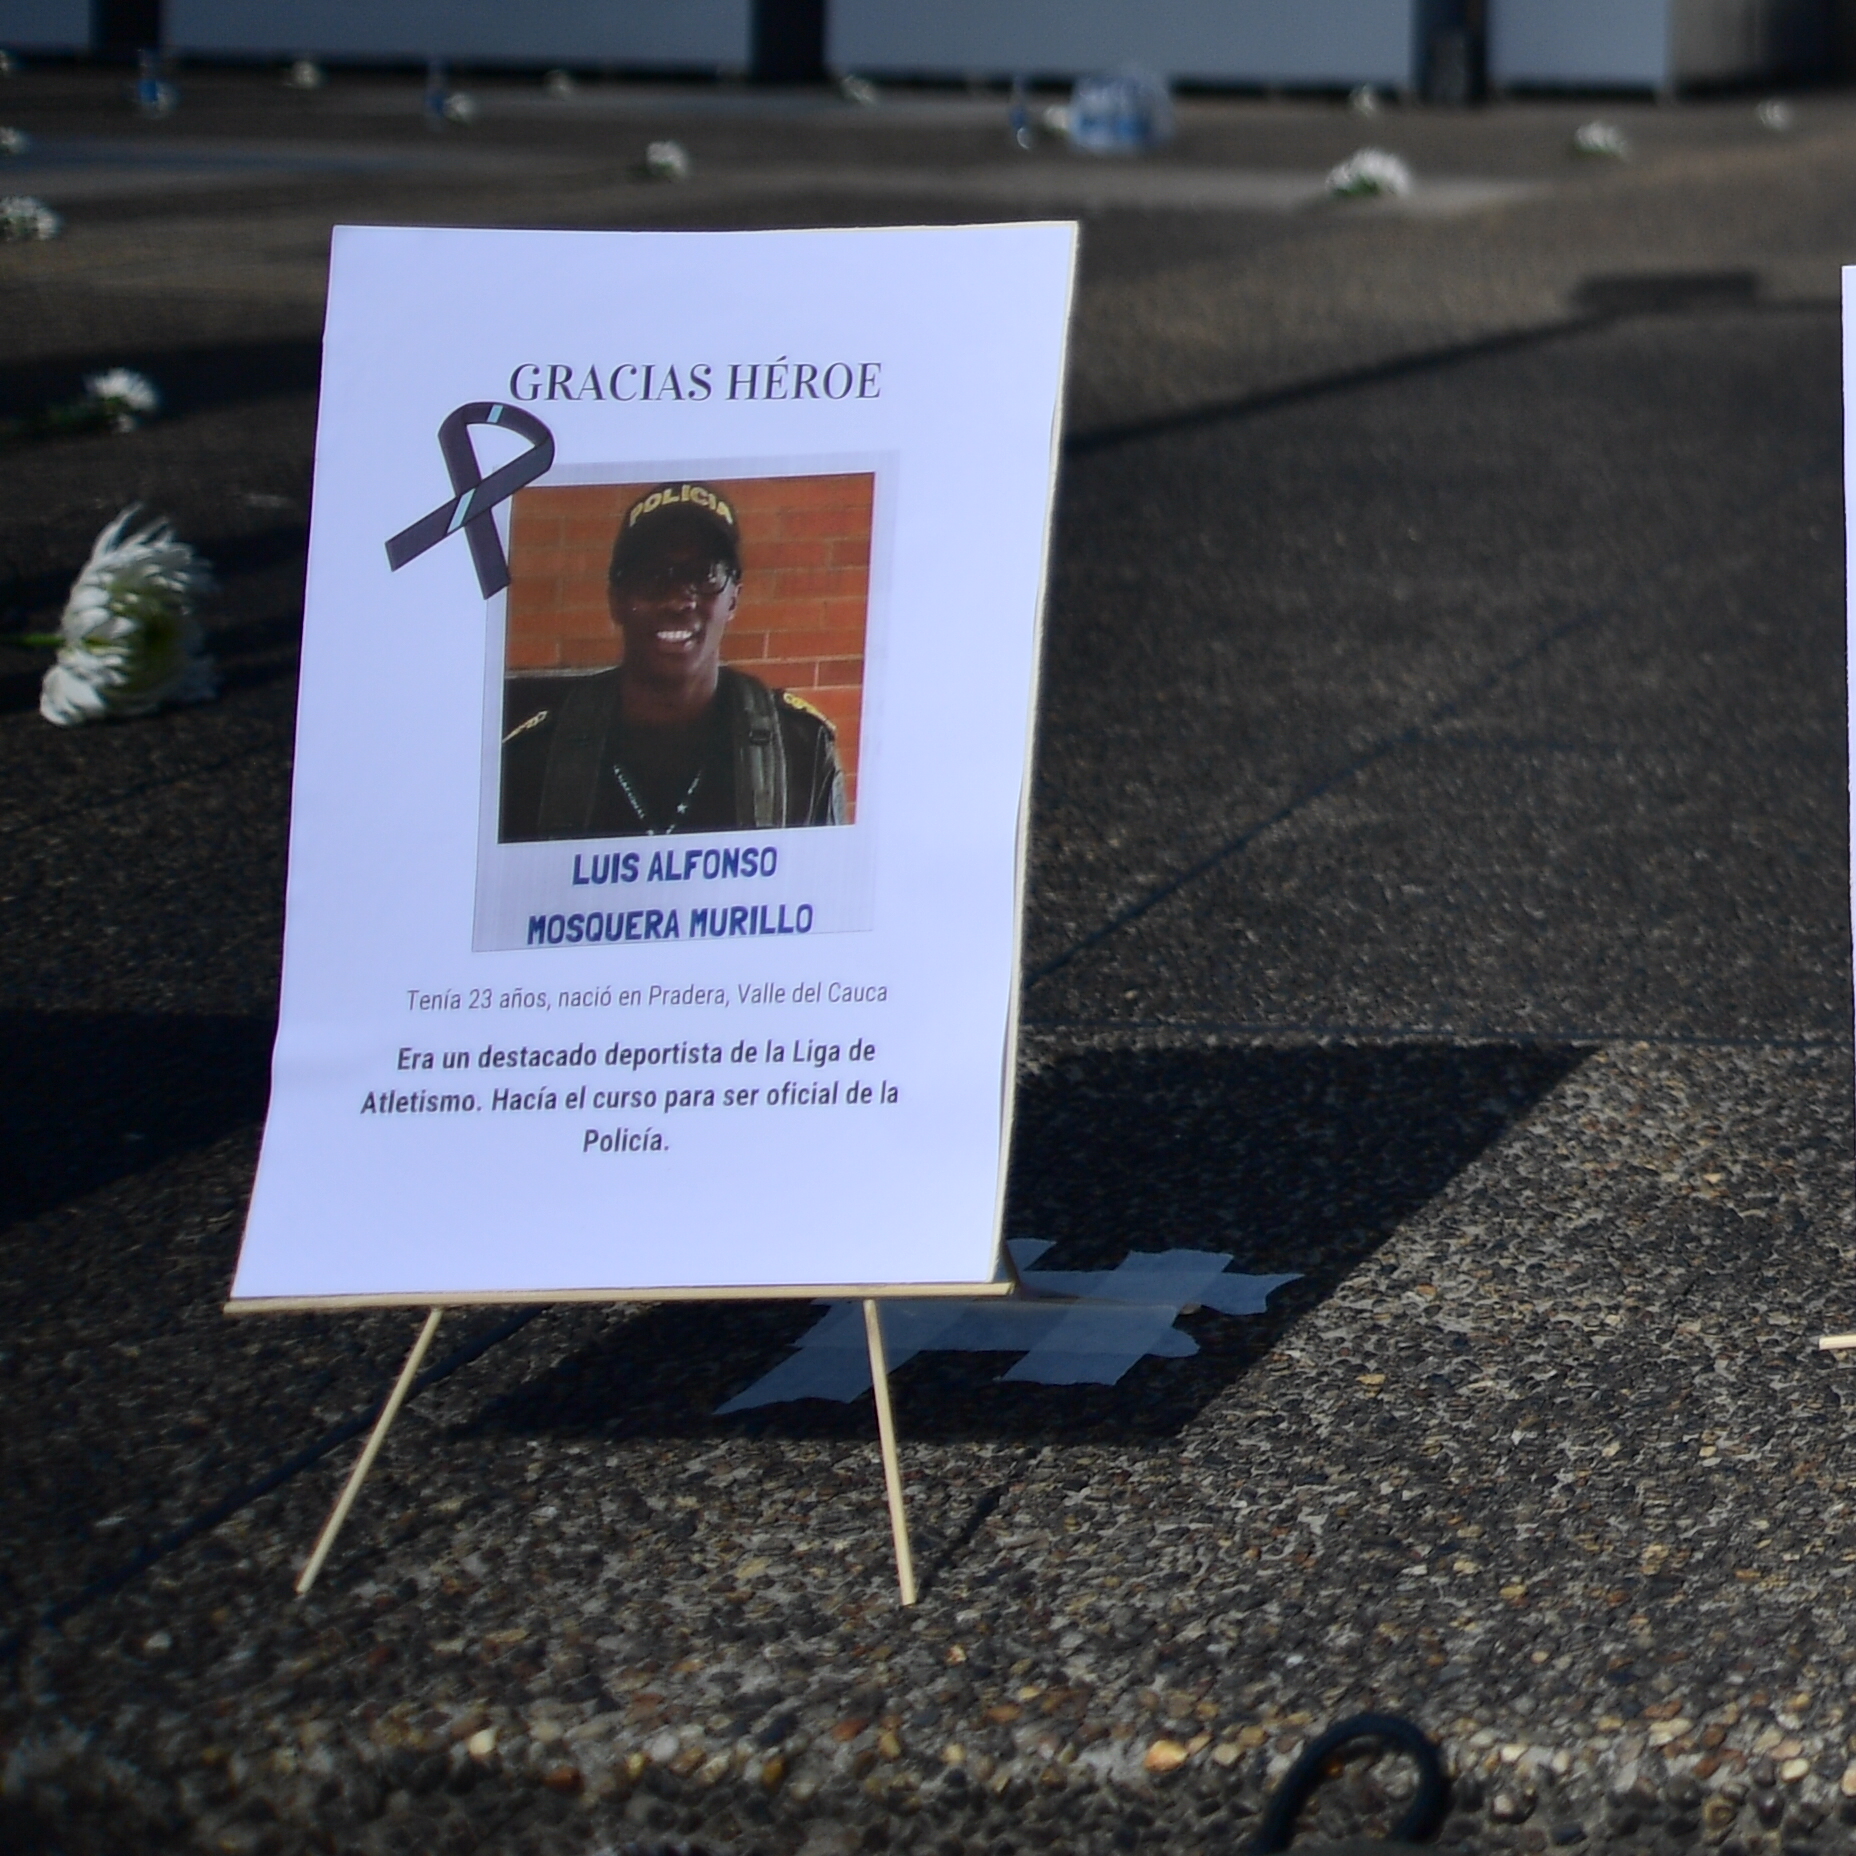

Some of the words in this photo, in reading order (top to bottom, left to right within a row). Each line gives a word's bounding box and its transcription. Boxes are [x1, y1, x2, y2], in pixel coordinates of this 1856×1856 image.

[510, 363, 712, 401] GRACIAS
[726, 355, 881, 400] HÉROE
[630, 484, 733, 527] POLICIA
[572, 852, 640, 885] LUIS
[647, 846, 777, 882] ALFONSO
[527, 909, 680, 945] MOSQUERA
[689, 904, 813, 938] MURILLO
[407, 988, 461, 1011] Tenía
[468, 988, 492, 1009] 23
[499, 987, 551, 1011] años,
[558, 985, 612, 1007] nació
[619, 990, 641, 1006] en
[648, 984, 730, 1008] Pradera,
[738, 982, 786, 1004] Valle
[792, 981, 822, 1003] del
[828, 982, 887, 1003] Cauca
[397, 1047, 434, 1070] Era
[442, 1051, 470, 1069] un
[478, 1042, 597, 1068] destacado
[605, 1041, 722, 1071] deportista
[730, 1040, 758, 1063] de
[765, 1039, 785, 1063] la
[793, 1039, 840, 1068] Liga
[849, 1038, 875, 1061] de
[360, 1089, 481, 1114] Atletismo.
[492, 1086, 557, 1111] Hacía
[565, 1085, 586, 1109] el
[593, 1090, 657, 1109] curso
[664, 1089, 715, 1114] para
[723, 1088, 760, 1106] ser
[767, 1080, 839, 1105] oficial
[846, 1080, 873, 1104] de
[880, 1080, 898, 1104] la
[583, 1127, 669, 1153] Policía.
